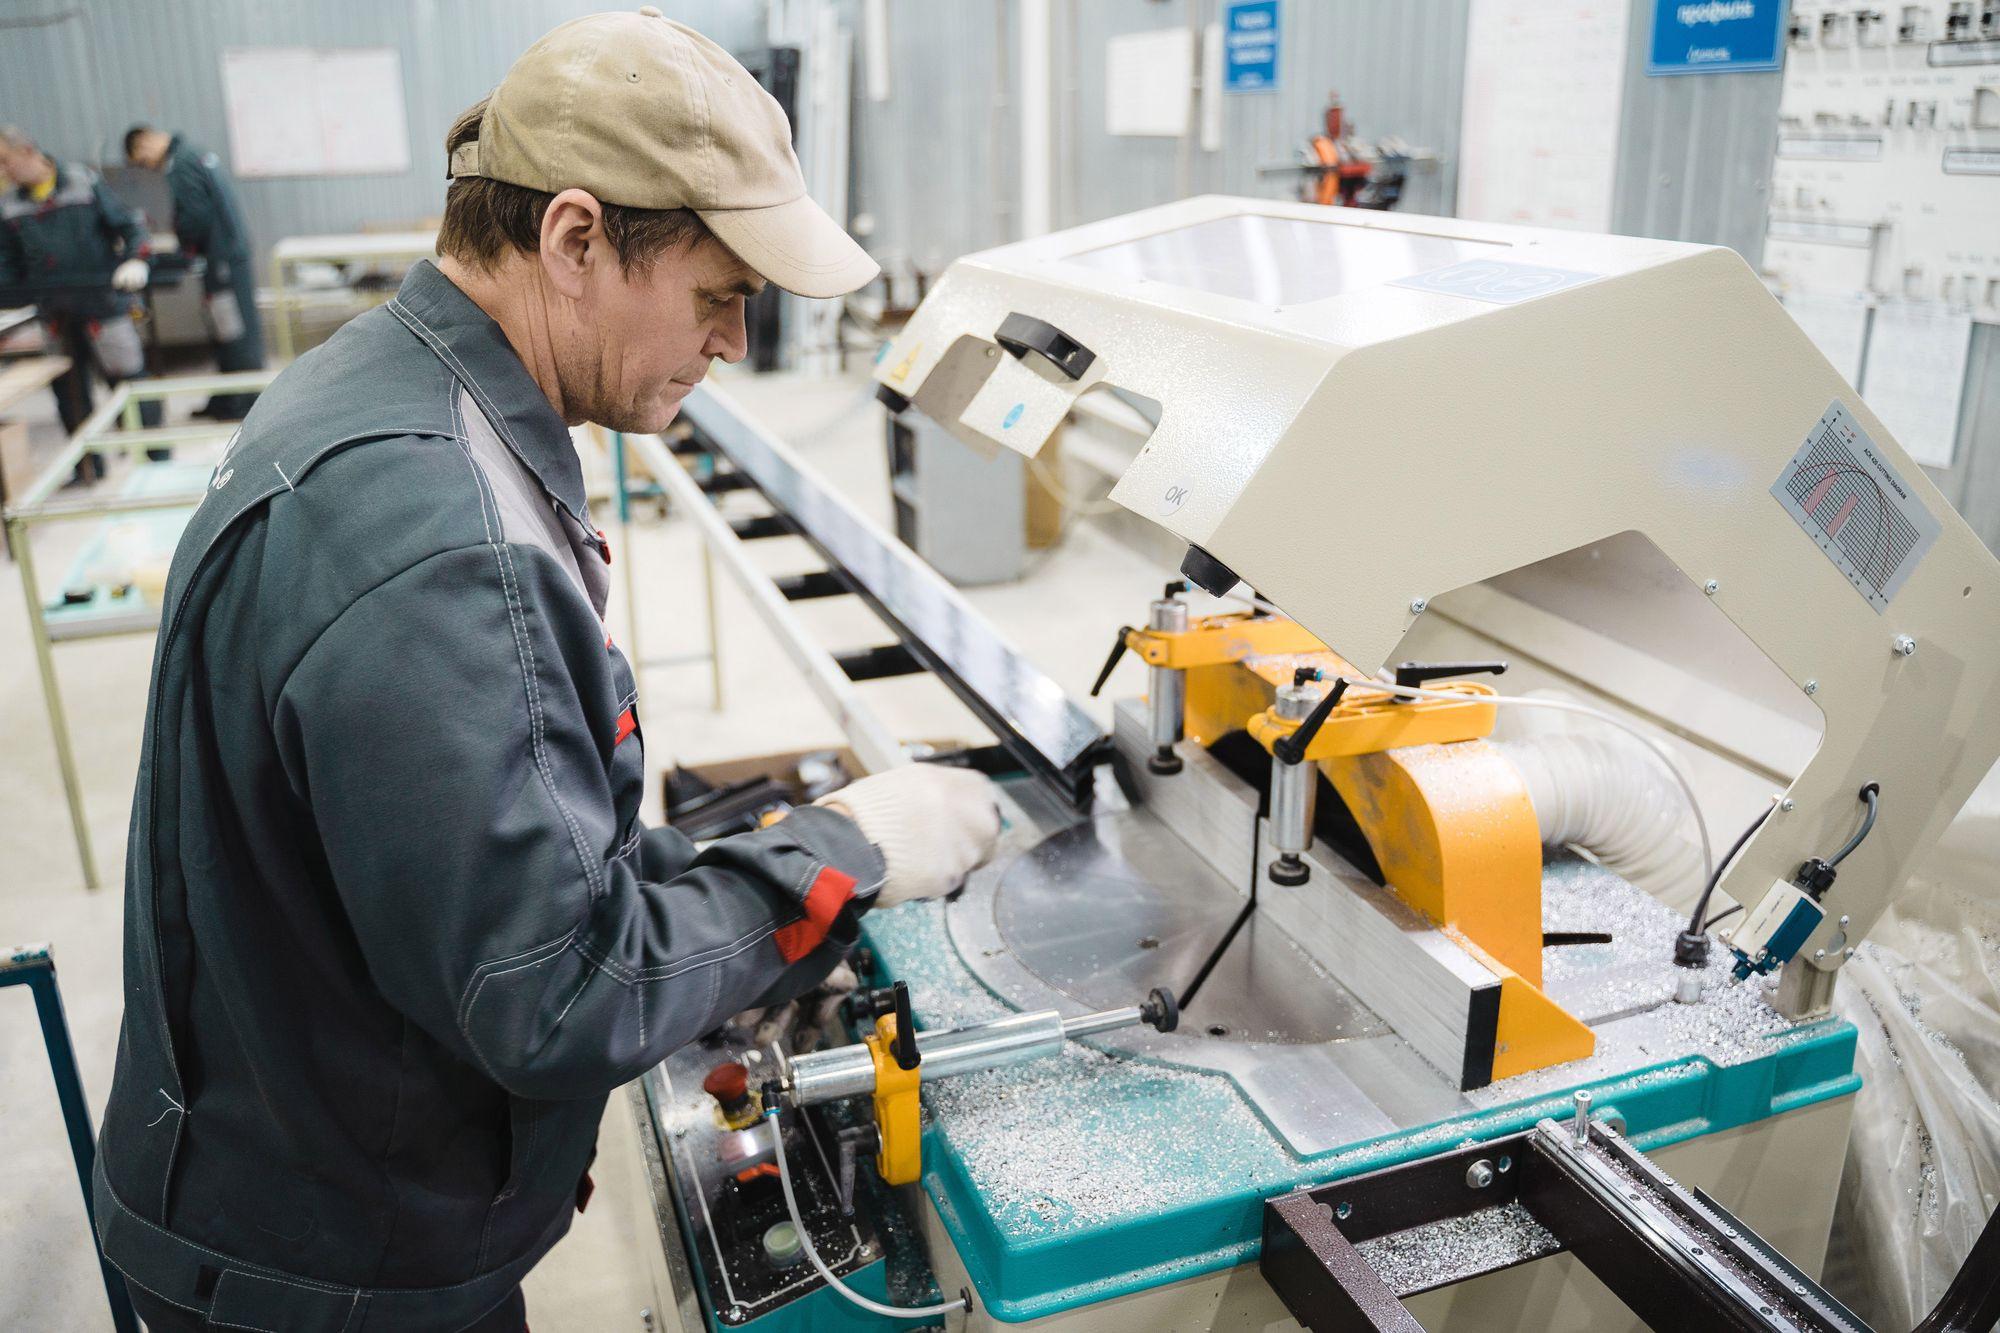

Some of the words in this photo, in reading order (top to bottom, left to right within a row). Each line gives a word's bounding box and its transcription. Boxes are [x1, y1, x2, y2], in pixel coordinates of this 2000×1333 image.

[1165, 486, 1188, 505] OK
[1876, 463, 1893, 482] CUTTING
[1890, 479, 1907, 500] DIAGRAM
